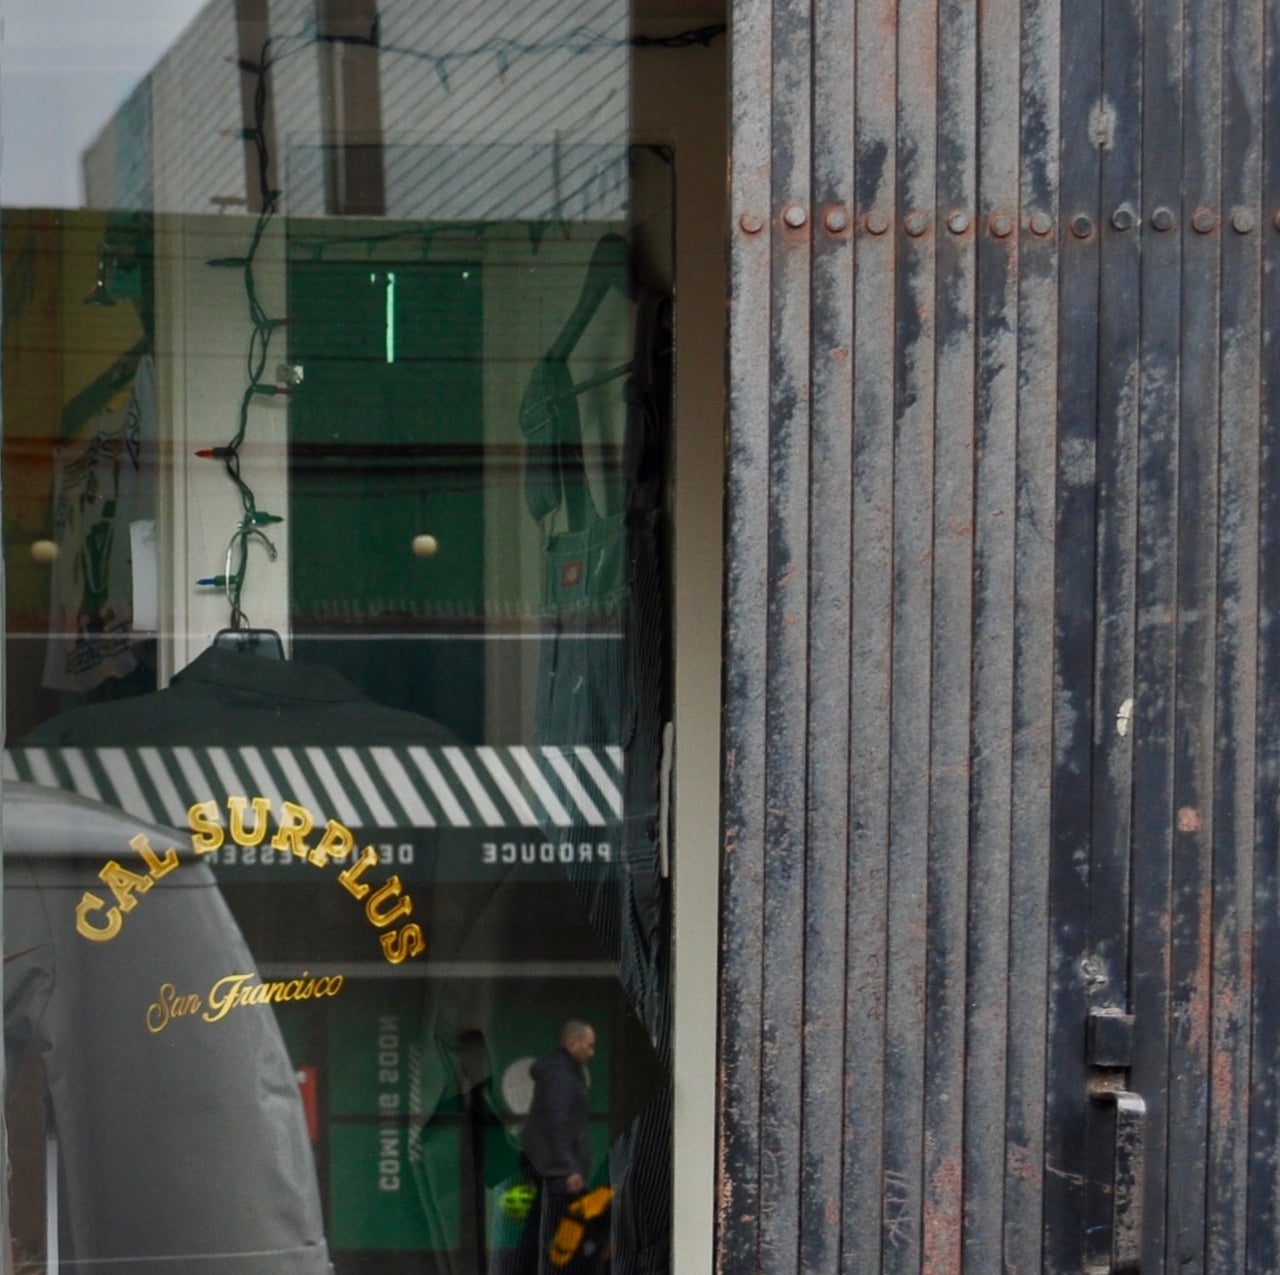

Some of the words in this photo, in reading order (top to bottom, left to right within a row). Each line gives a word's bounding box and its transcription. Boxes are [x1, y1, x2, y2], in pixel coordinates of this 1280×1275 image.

[75, 833, 180, 942] CAL
[187, 796, 425, 964] SURPLUS
[146, 983, 202, 1033] San
[202, 971, 345, 1023] Francisco
